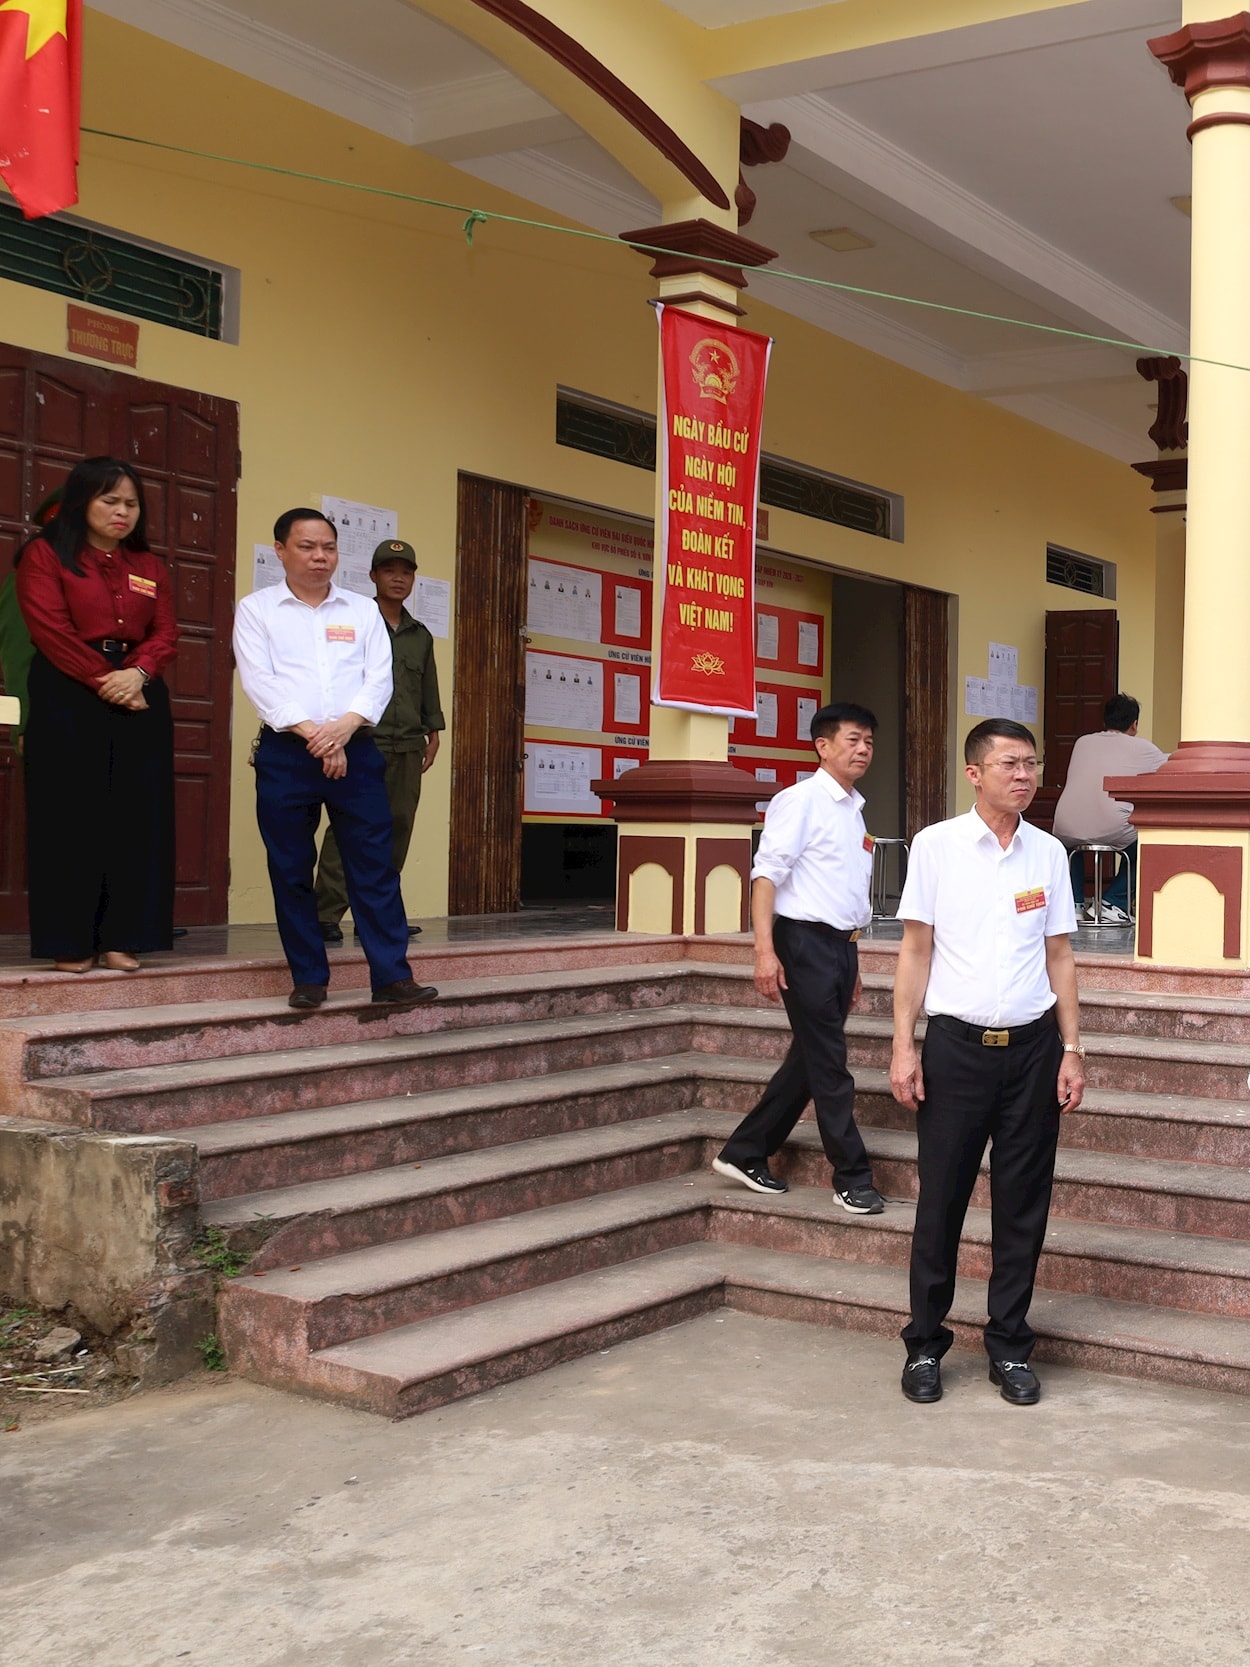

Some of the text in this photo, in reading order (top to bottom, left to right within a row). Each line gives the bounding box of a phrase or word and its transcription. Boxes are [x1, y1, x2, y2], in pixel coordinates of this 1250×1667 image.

[673, 414, 750, 455] NGÀY BẦU CỬ
[684, 454, 736, 492] NGÀY HỘI
[669, 483, 747, 529] CỦA NIỀM TIN,
[681, 525, 735, 560] ĐOÀN KẾT
[667, 561, 745, 600] VÀ KHÁT VỌNG
[679, 601, 734, 633] VIỆT NAM!
